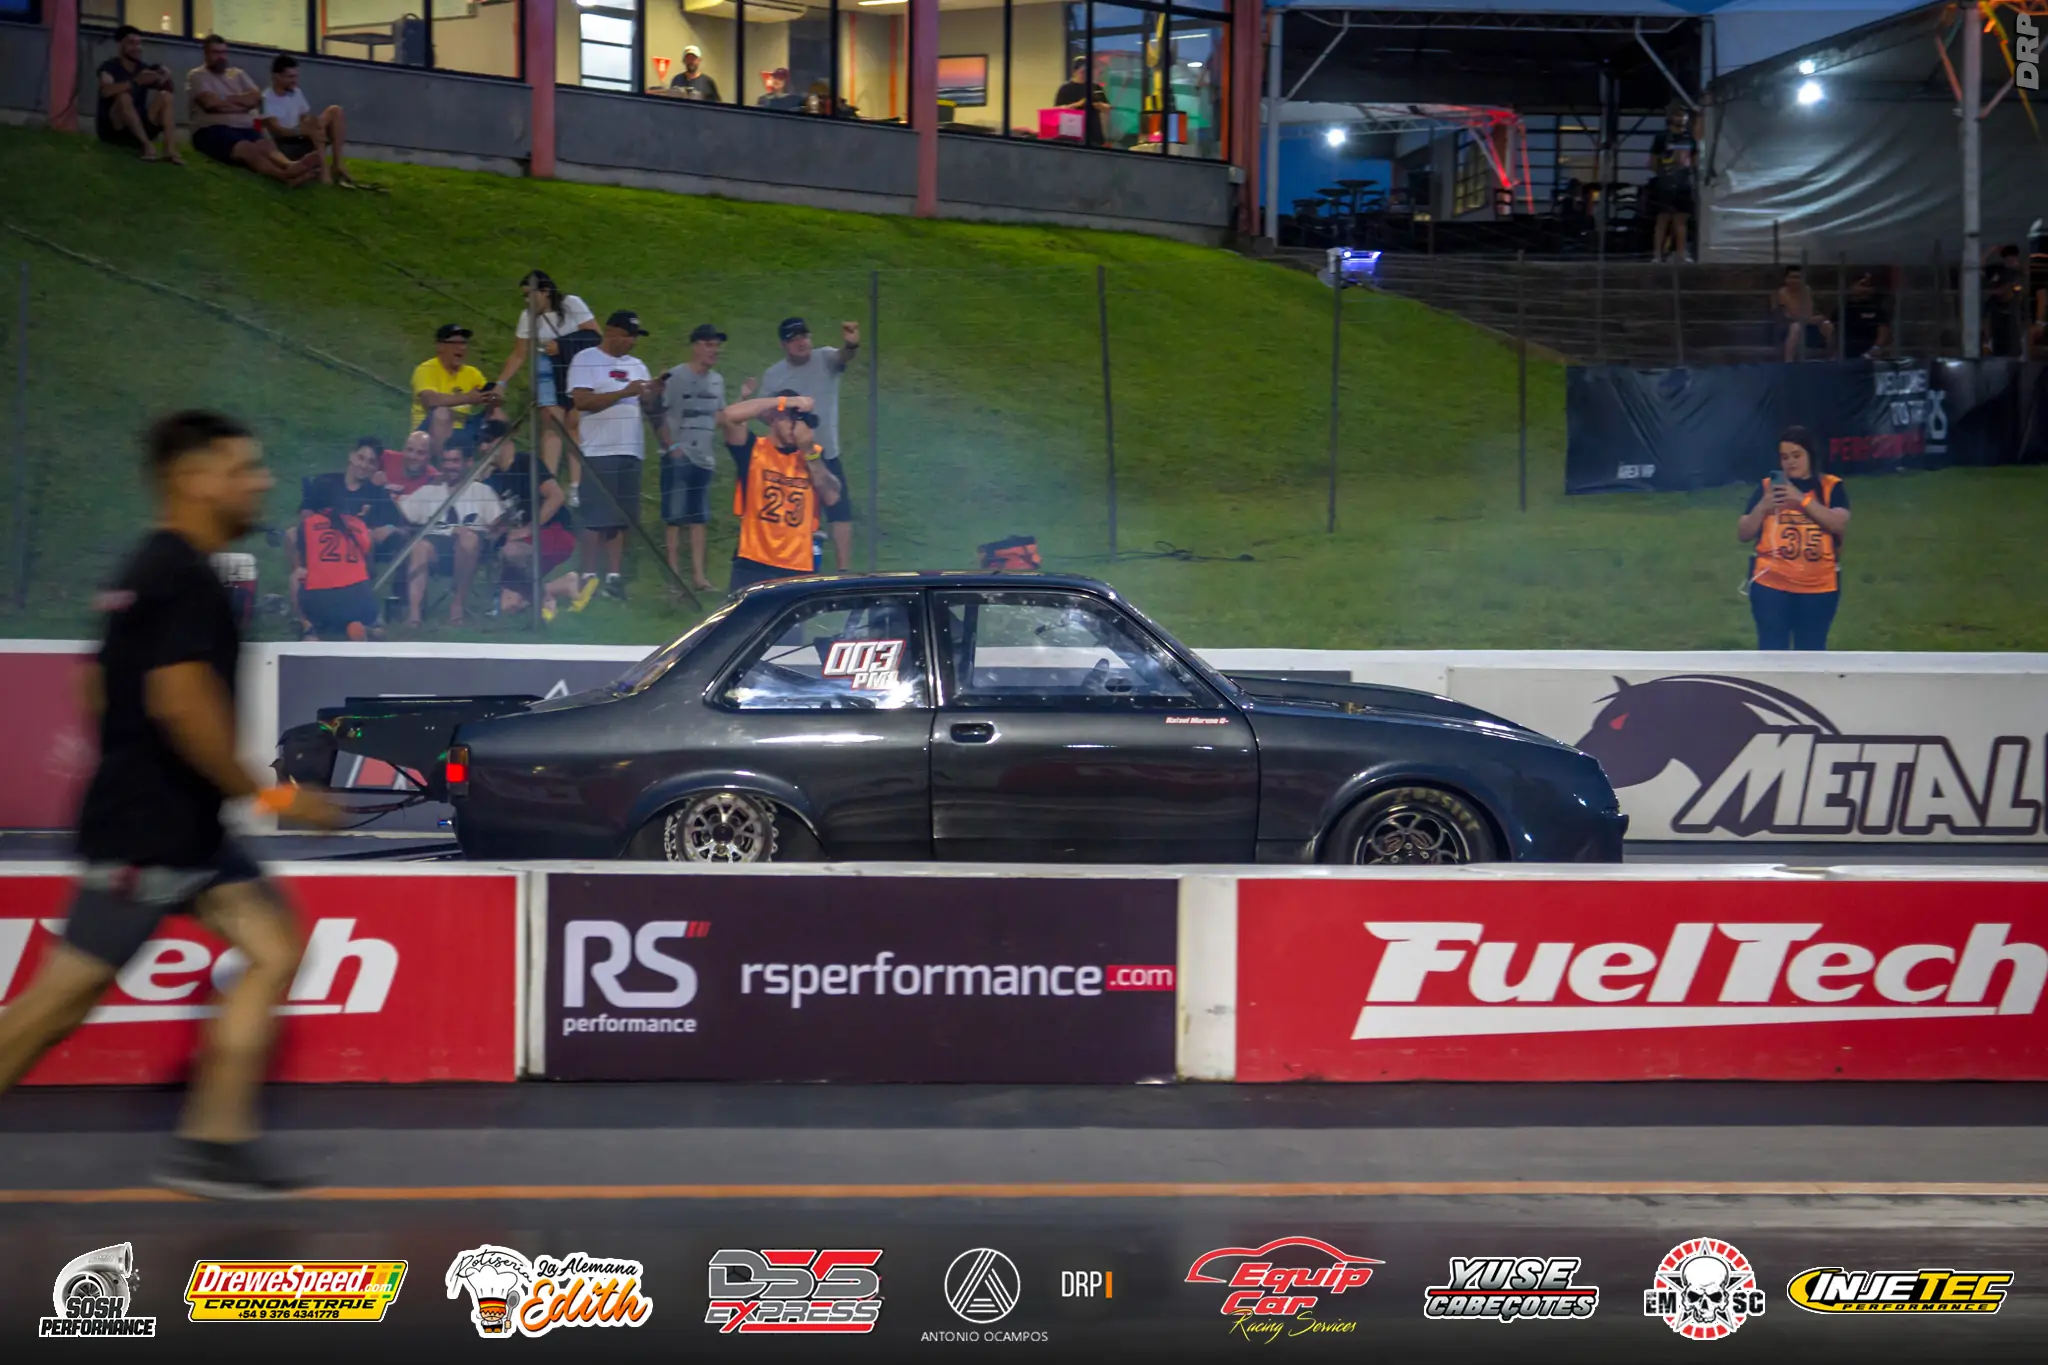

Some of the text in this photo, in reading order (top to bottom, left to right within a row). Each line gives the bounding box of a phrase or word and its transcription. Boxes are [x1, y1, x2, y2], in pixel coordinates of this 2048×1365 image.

[758, 485, 805, 527] 23
[1779, 526, 1822, 562] 35
[823, 640, 905, 676] 003
[1671, 726, 2048, 836] METAL
[563, 920, 704, 1008] RS
[1364, 921, 2048, 1014] FuelTech
[562, 1013, 697, 1036] performance
